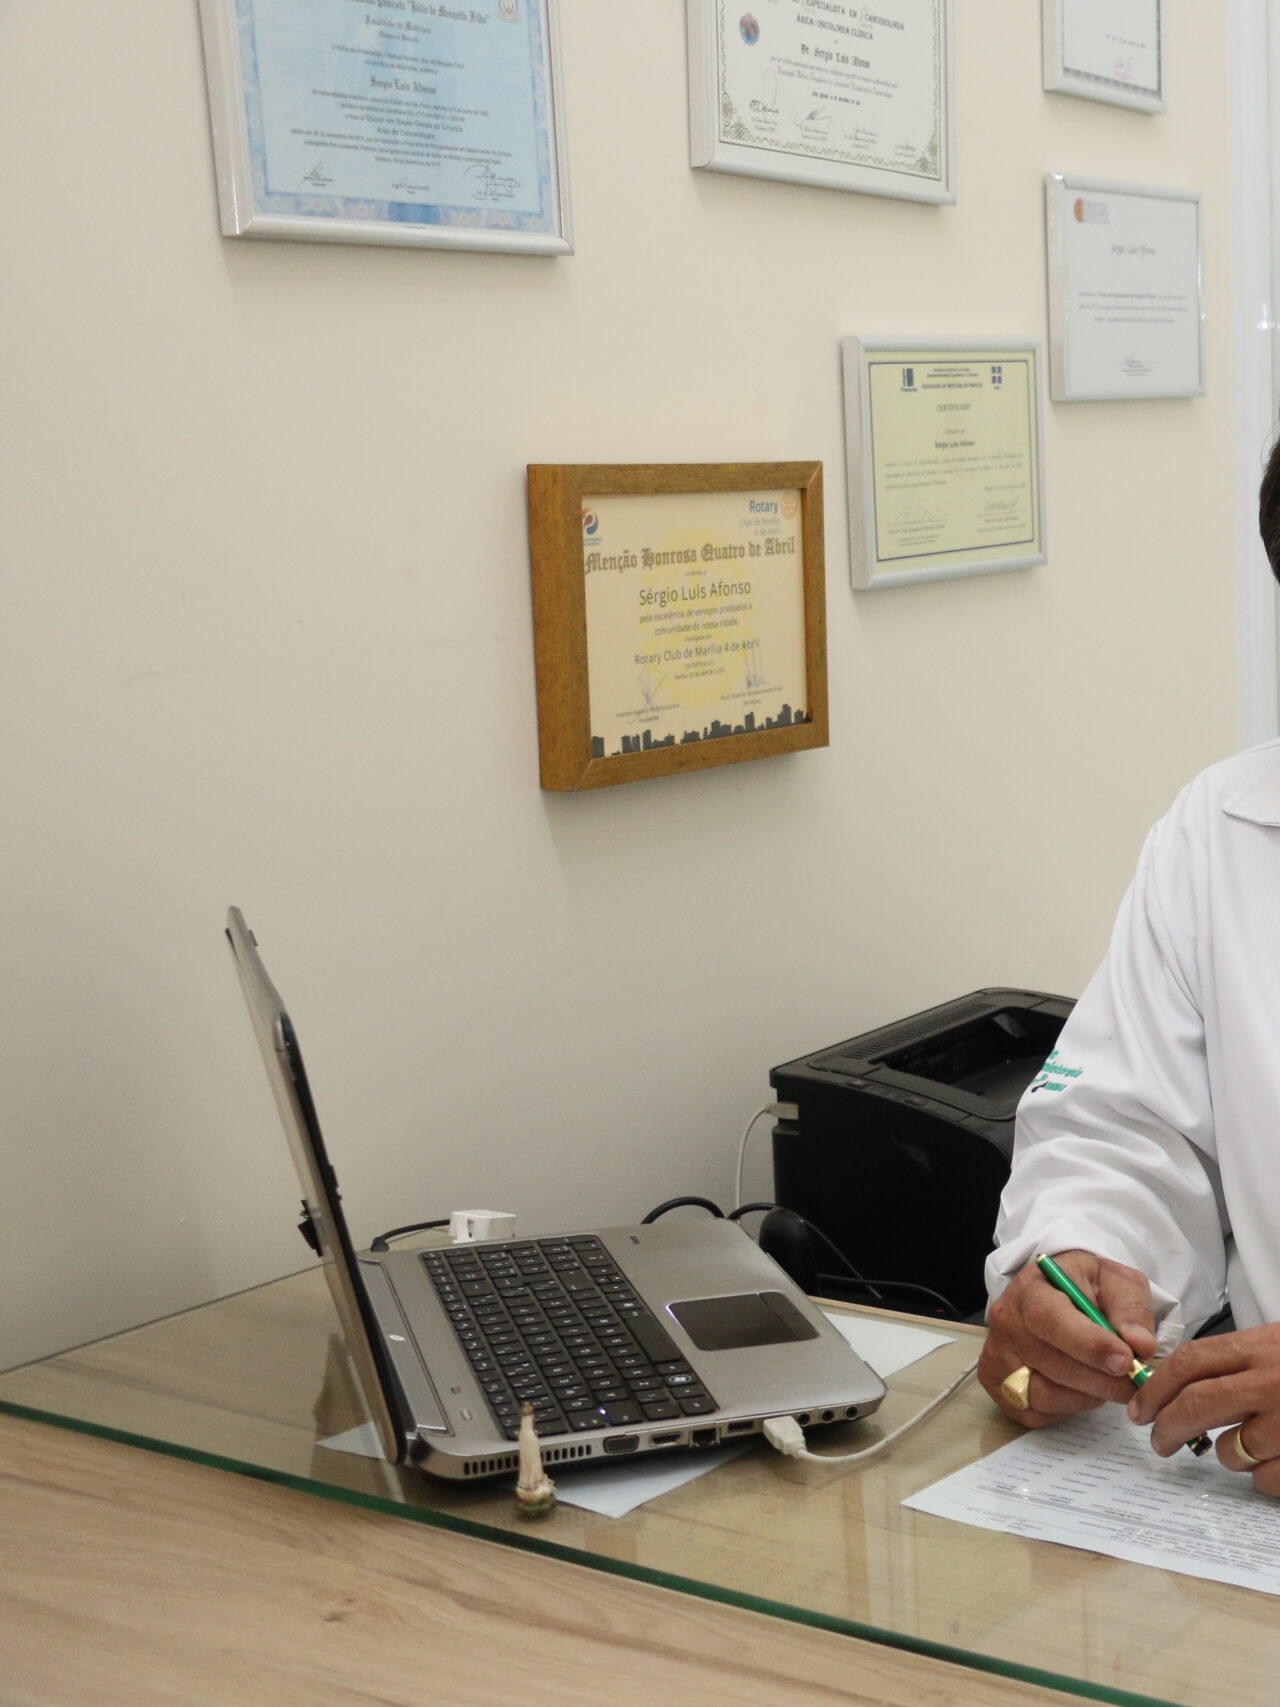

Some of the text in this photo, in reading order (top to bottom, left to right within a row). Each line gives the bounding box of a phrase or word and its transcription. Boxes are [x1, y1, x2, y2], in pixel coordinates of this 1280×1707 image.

[749, 500, 779, 514] Rotary
[585, 536, 796, 575] Menção Honrosa Quatro de Abril
[639, 580, 752, 608] Sérgio Luis Afonso
[686, 609, 693, 618] de
[654, 624, 691, 636] comunidade
[692, 622, 700, 631] de
[635, 638, 760, 665] Rotary Club de Marília 4 de Abril
